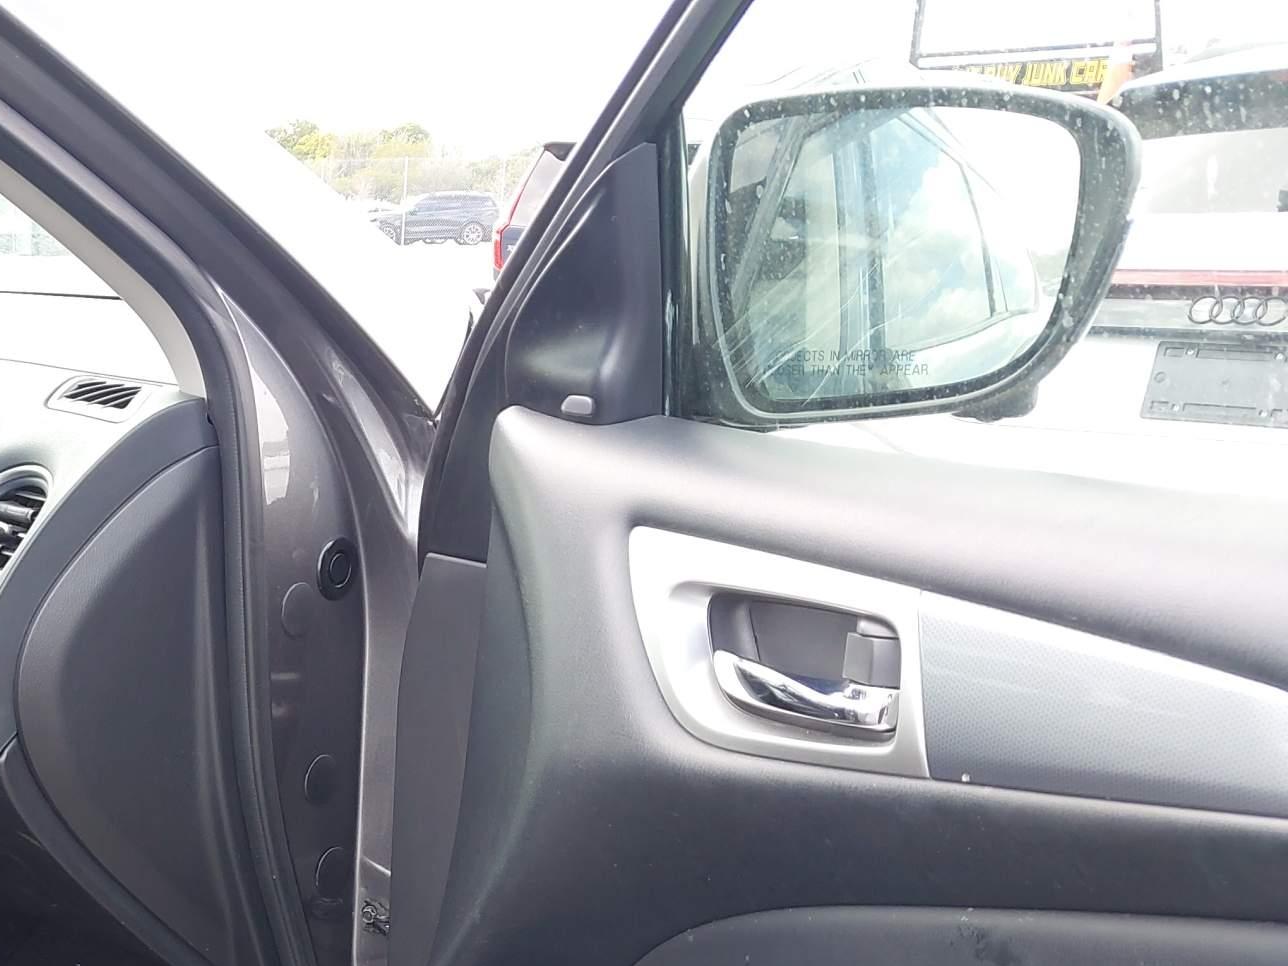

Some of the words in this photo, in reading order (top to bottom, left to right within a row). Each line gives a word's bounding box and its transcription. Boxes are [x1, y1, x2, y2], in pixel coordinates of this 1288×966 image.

[1024, 61, 1067, 86] JUNK
[775, 349, 825, 362] OJECTS
[829, 349, 840, 361] IN
[891, 350, 916, 361] ARE
[763, 363, 805, 377] OSER
[809, 364, 840, 376] THAN
[880, 364, 929, 376] APPEAR
